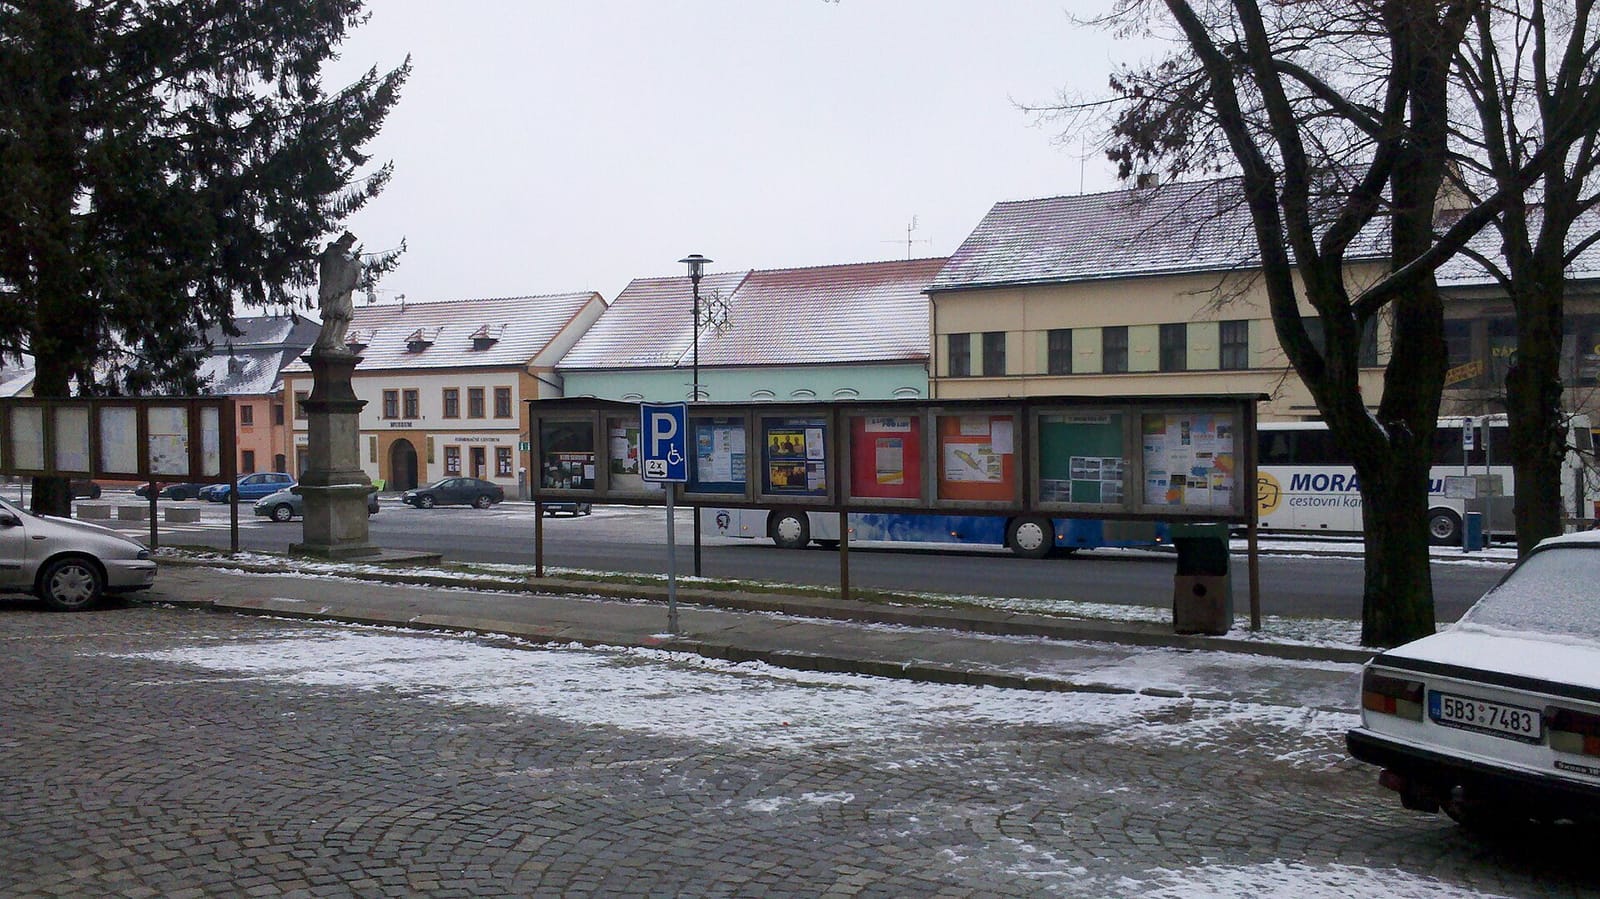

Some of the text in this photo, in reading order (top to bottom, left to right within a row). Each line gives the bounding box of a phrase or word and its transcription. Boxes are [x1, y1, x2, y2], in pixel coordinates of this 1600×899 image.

[652, 413, 677, 457] P
[1290, 473, 1361, 492] MORA
[1289, 495, 1340, 507] cestovní
[1444, 698, 1475, 721] 5B3
[1488, 706, 1532, 732] 7483
